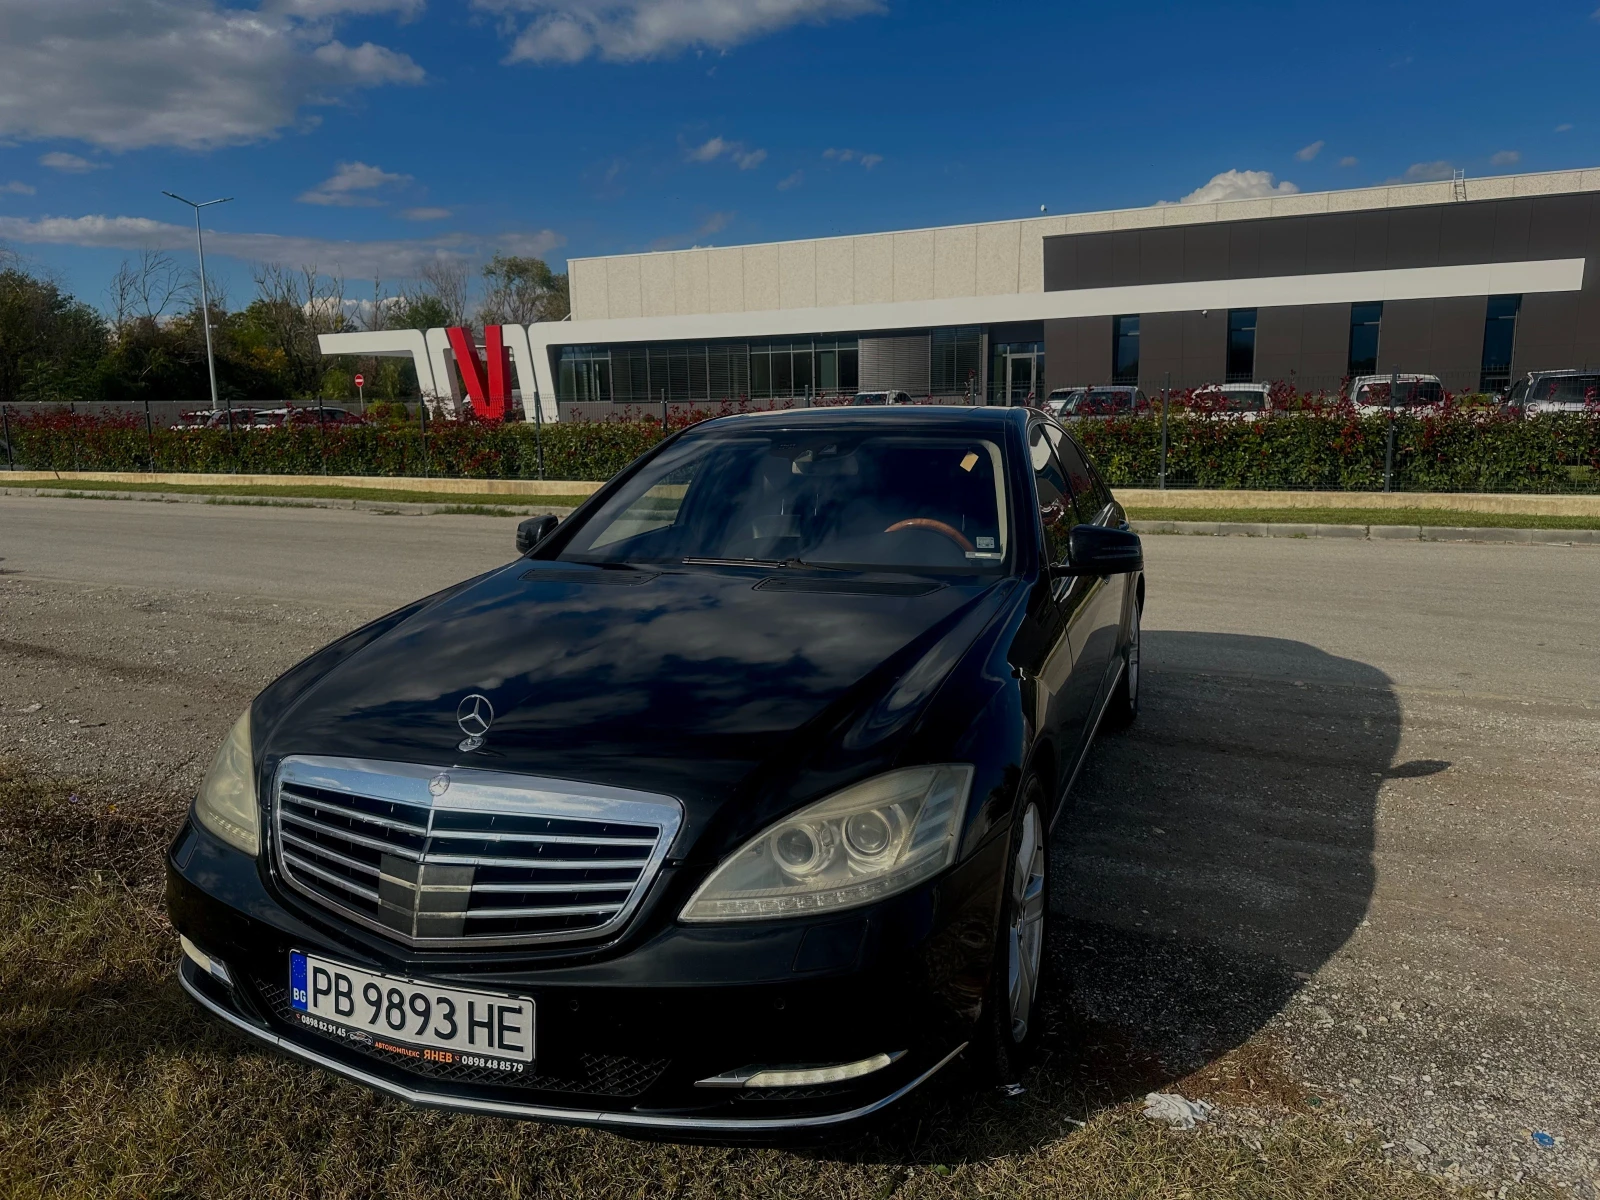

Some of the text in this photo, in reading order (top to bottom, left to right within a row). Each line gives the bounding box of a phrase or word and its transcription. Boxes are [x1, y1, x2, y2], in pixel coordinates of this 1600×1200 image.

[293, 988, 307, 1003] BG
[312, 965, 525, 1053] PB 9893 HE
[301, 1015, 346, 1037] 0898 82 91 45
[374, 1041, 453, 1063] АВТОКОМПЛЕКС ЯНЕВ
[461, 1055, 524, 1072] 0898 48 85 79
